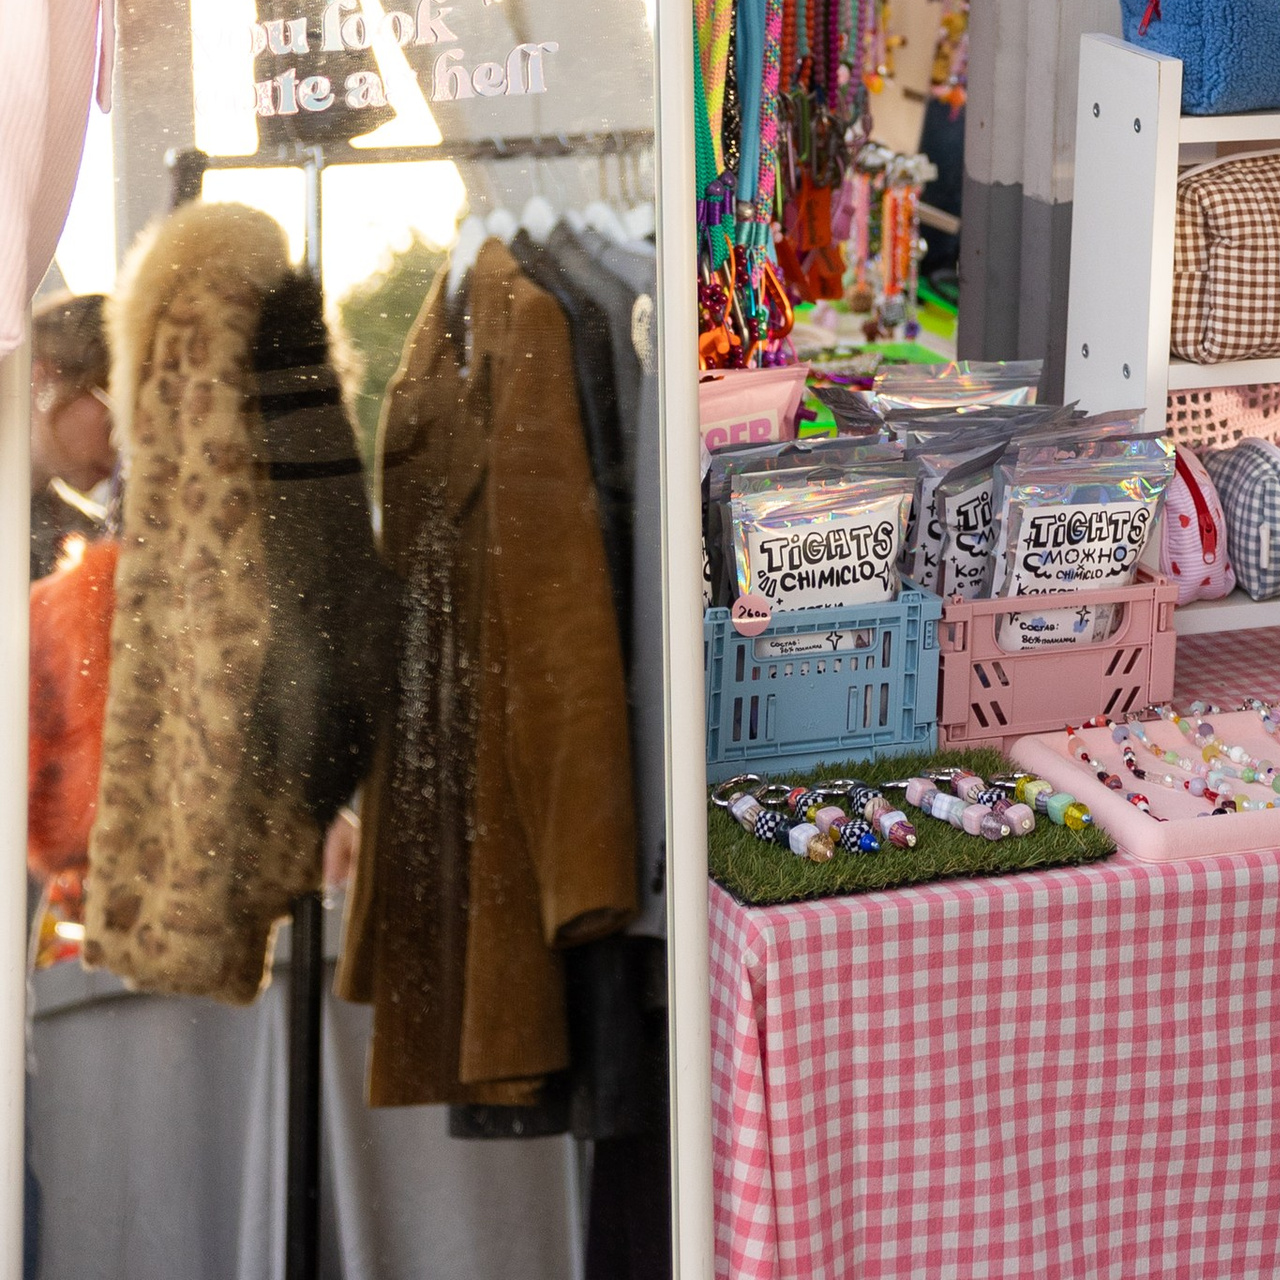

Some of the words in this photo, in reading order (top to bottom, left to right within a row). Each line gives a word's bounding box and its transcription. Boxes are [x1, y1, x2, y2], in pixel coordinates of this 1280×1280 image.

[430, 41, 560, 102] hell
[780, 560, 876, 592] CHIMICLO
[1055, 569, 1104, 581] CHIMICLO
[738, 605, 768, 619] 2600
[1022, 634, 1041, 644] 86%
